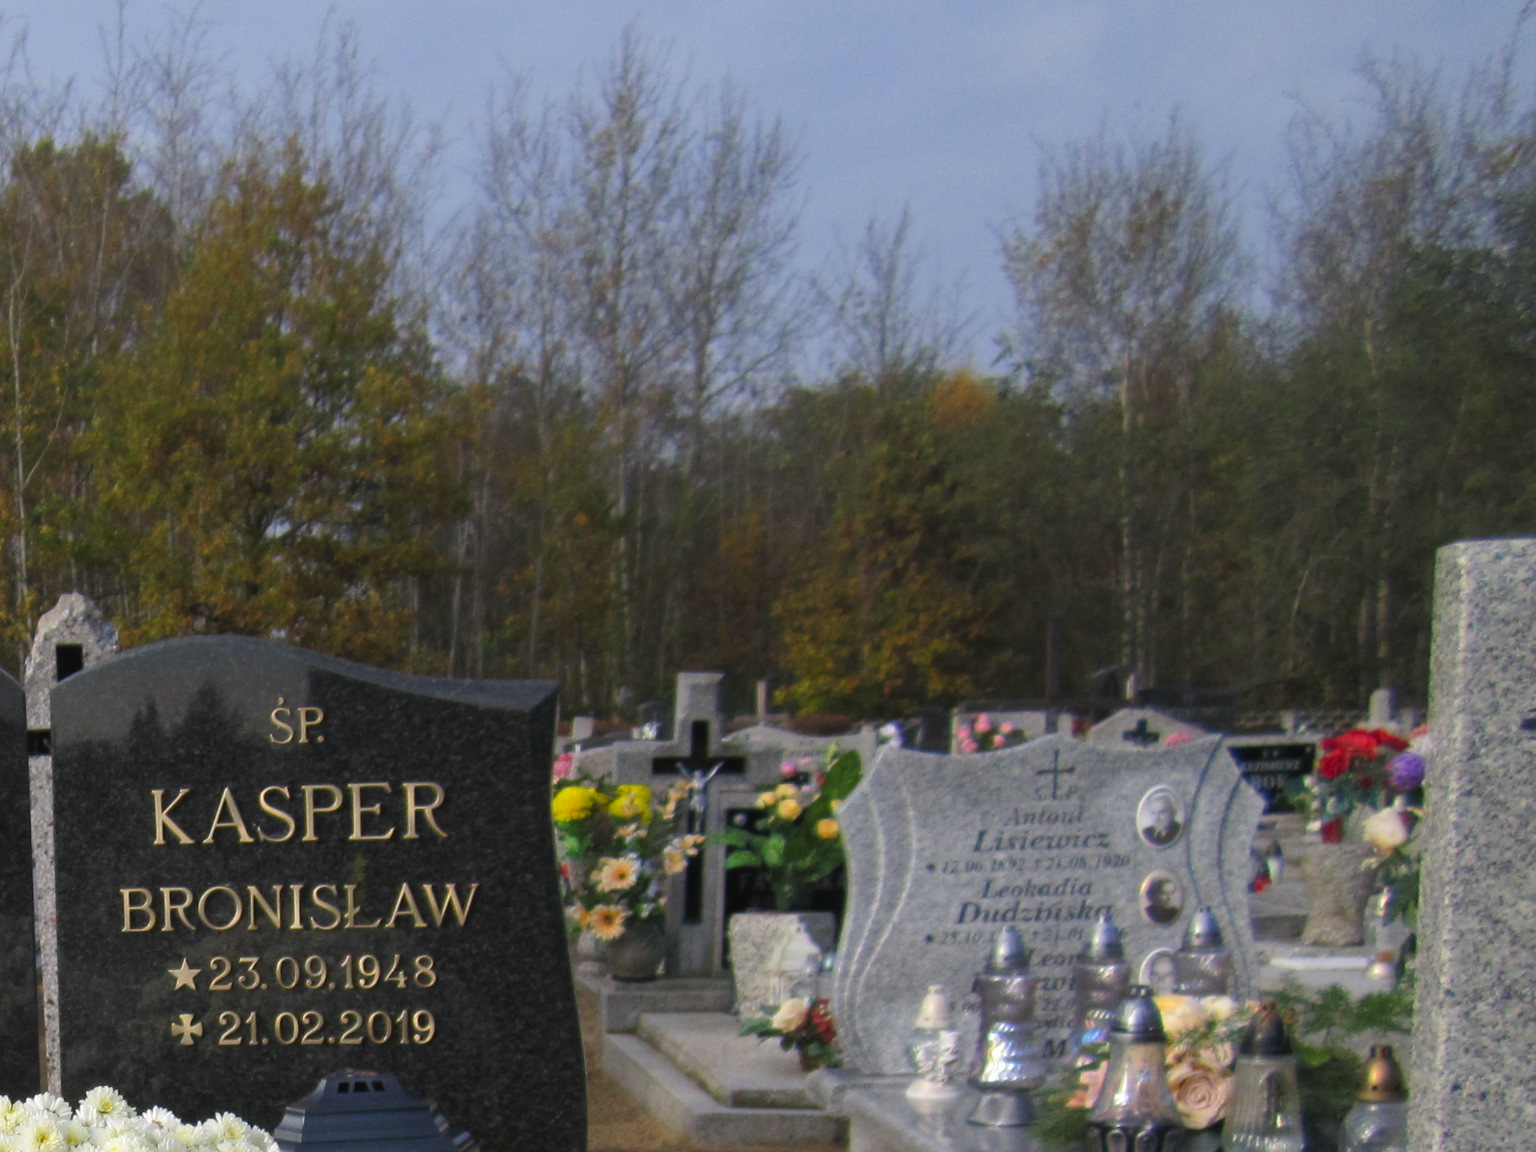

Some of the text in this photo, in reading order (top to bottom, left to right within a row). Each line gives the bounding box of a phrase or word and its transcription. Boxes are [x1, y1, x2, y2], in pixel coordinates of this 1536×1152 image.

[268, 697, 326, 745] ŚP.
[150, 781, 449, 846] KASPER
[119, 882, 480, 932] BRONISŁAW
[208, 954, 437, 991] 23.09.1948
[217, 1009, 436, 1046] 21.02.2019
